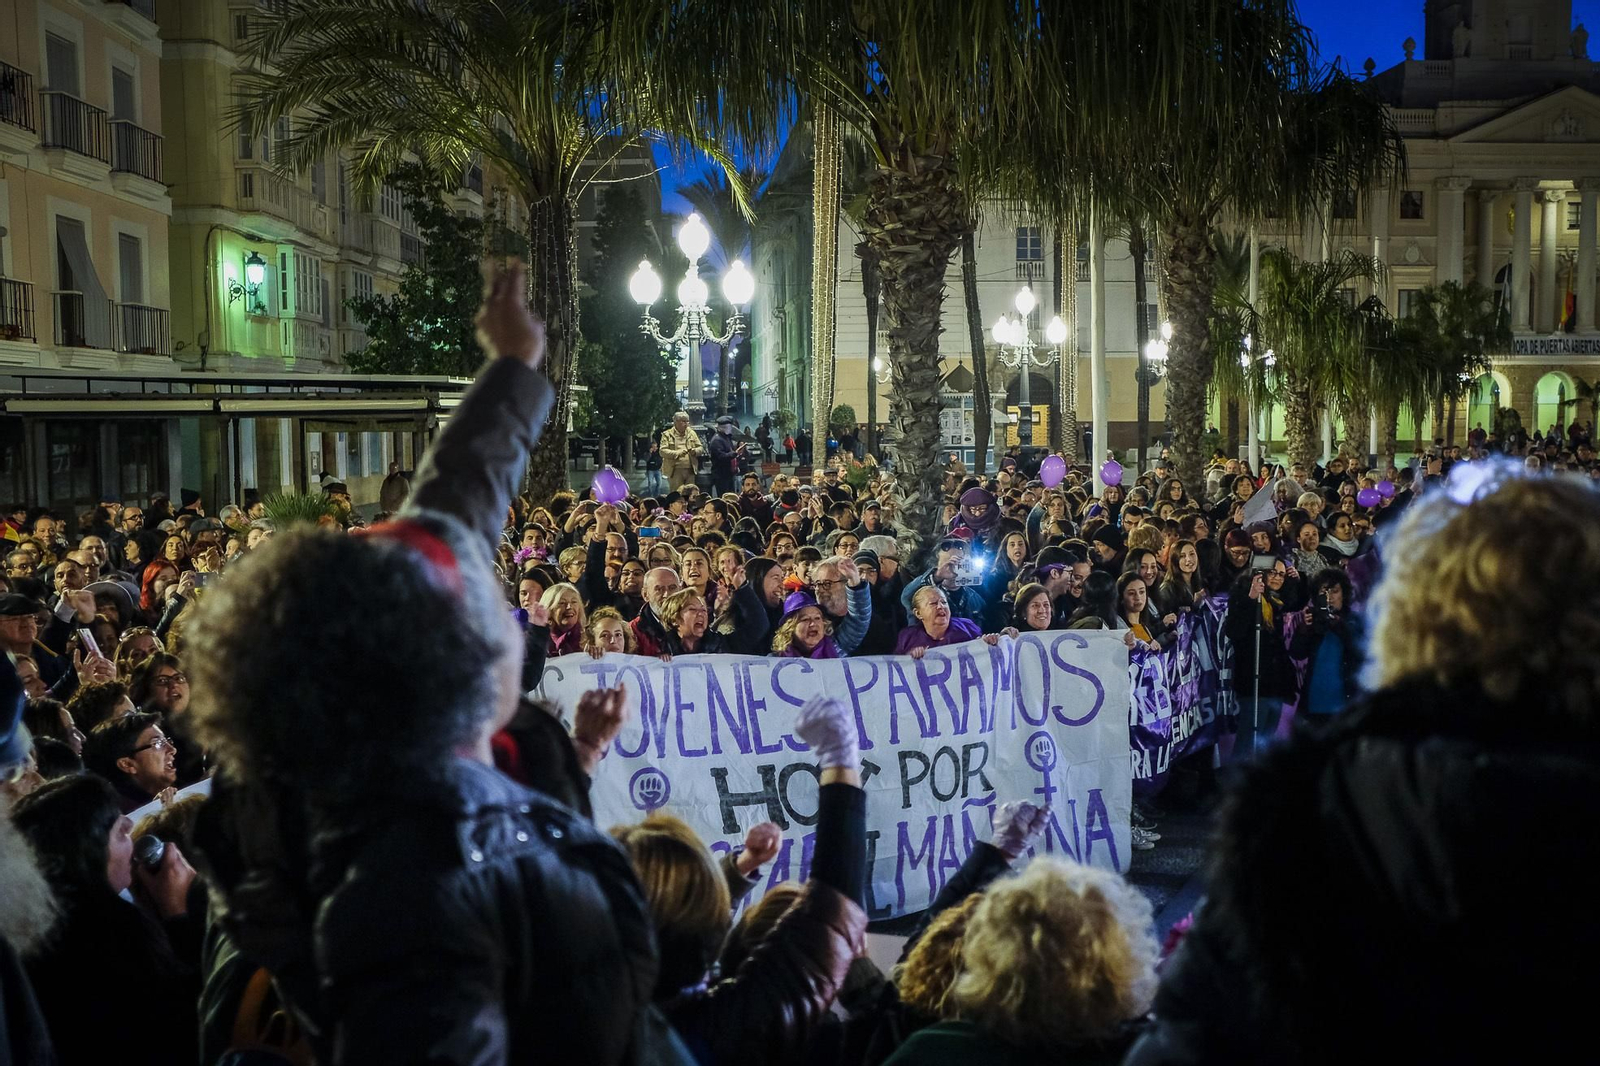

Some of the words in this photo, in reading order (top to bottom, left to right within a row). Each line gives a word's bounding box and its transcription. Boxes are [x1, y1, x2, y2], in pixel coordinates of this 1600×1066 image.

[1530, 339, 1538, 354] DE
[1540, 338, 1570, 353] PUERTAS
[842, 633, 1104, 750] PARAMOS
[710, 757, 881, 834] HO
[898, 741, 994, 809] POR
[896, 790, 1120, 911] MAÑNA
